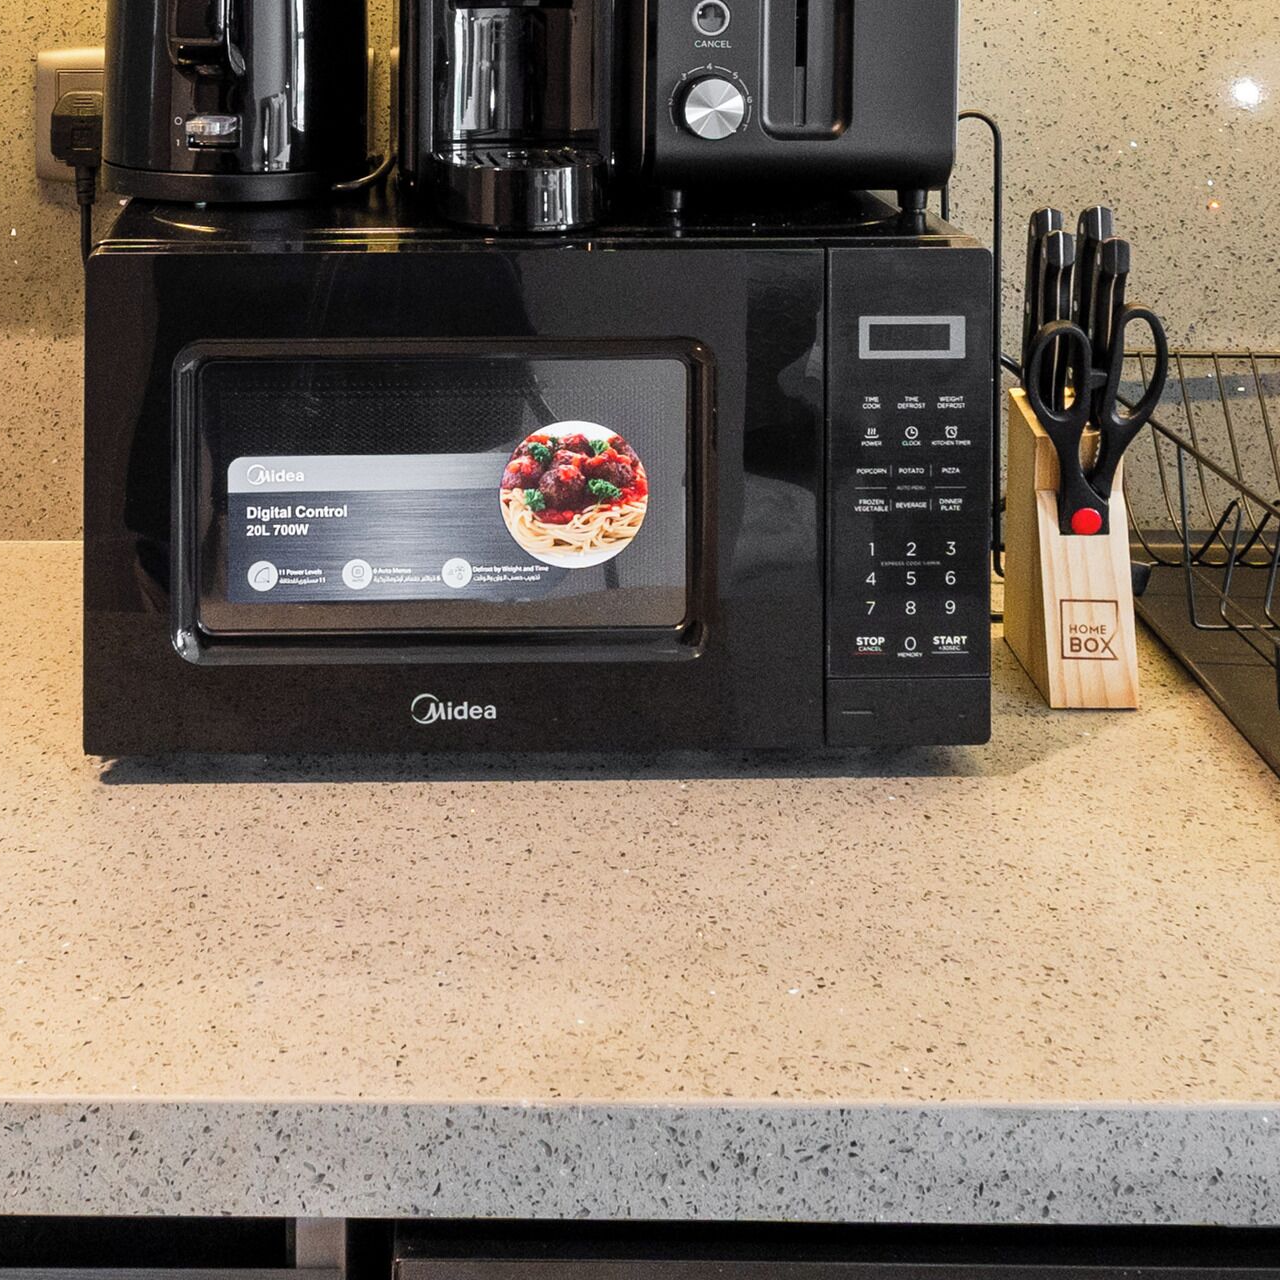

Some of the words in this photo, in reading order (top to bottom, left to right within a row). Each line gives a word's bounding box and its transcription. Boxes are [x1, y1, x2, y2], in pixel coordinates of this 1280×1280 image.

[694, 40, 732, 49] CANCEL
[732, 72, 739, 80] 5
[747, 96, 753, 104] 6
[248, 465, 305, 484] Midea
[246, 505, 292, 522] Digital
[295, 504, 348, 518] Control
[246, 524, 270, 537] 20L
[273, 523, 309, 536] 700W
[869, 542, 875, 556] 1
[906, 541, 917, 556] 2
[945, 541, 957, 556] 3
[286, 568, 304, 576] Power
[502, 565, 522, 573] Weight
[865, 571, 877, 586] 4
[906, 571, 917, 586] 5
[945, 570, 957, 586] 6
[865, 601, 876, 615] 7
[905, 601, 917, 615] 8
[945, 600, 956, 614] 9
[1070, 624, 1107, 634] HOME
[856, 636, 885, 646] STOP
[933, 636, 967, 645] START
[1070, 637, 1114, 654] BOX
[412, 694, 497, 724] Midea
